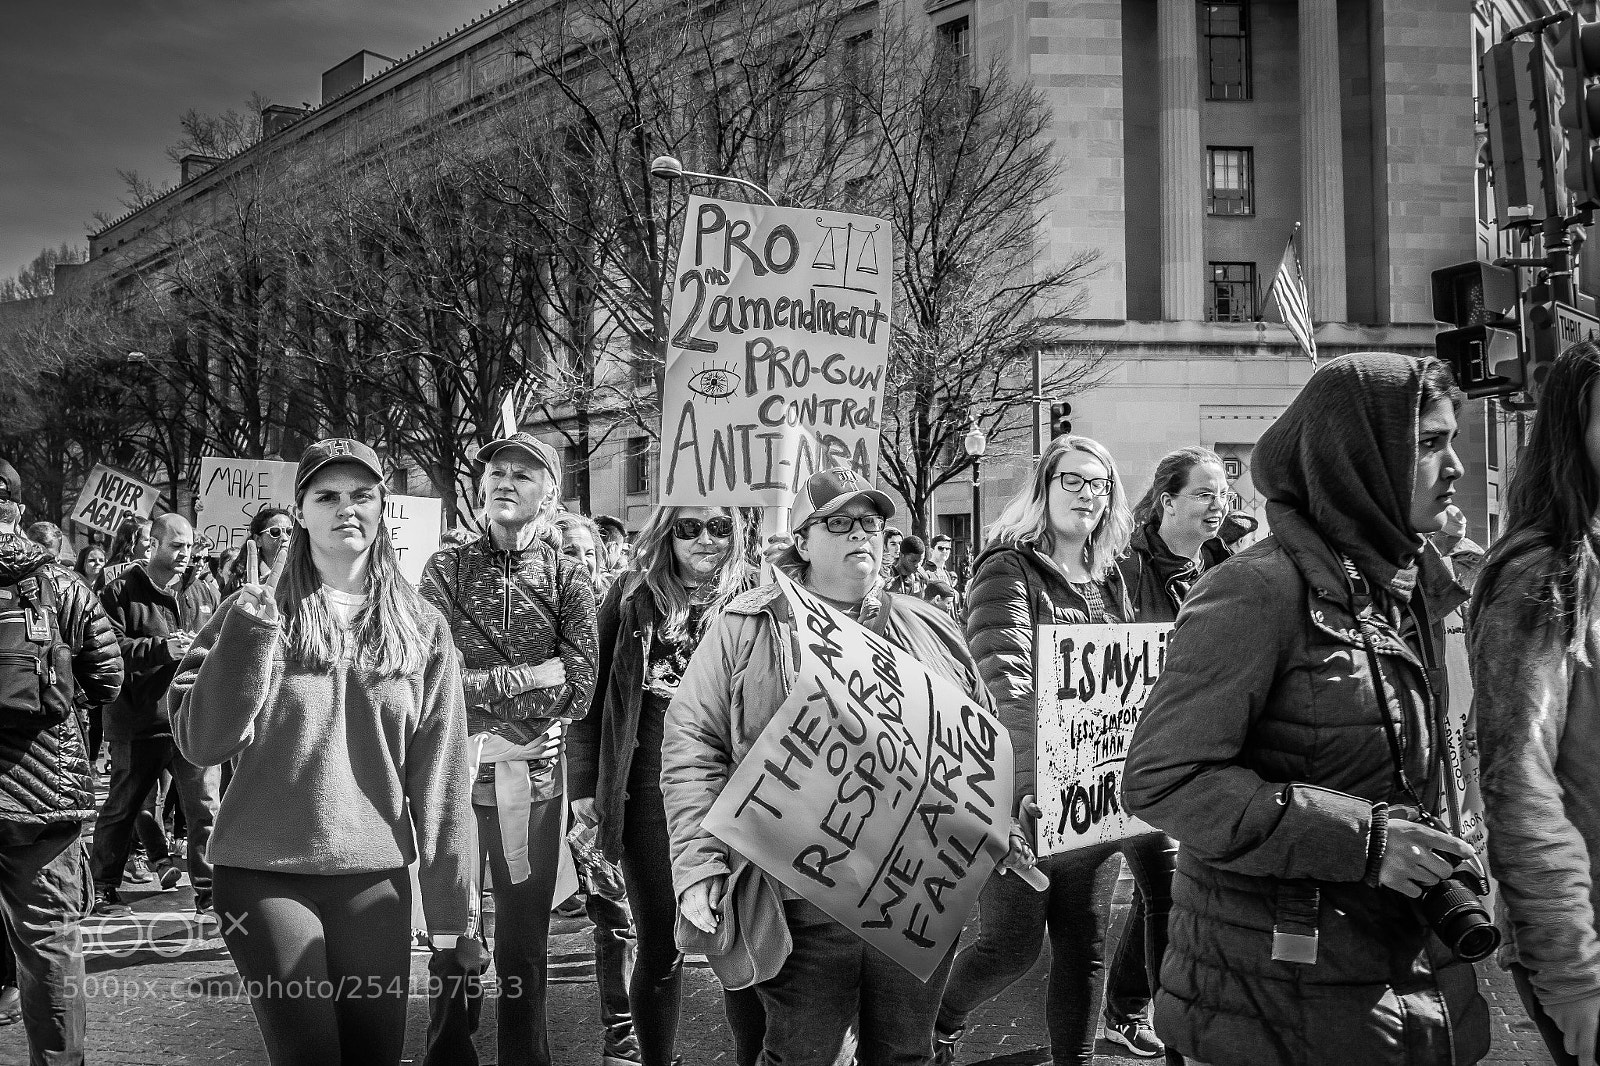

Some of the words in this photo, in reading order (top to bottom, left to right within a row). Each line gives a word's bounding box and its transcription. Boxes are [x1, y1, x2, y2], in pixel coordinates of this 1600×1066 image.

[695, 203, 800, 276] PRO
[708, 288, 889, 344] amendment
[744, 336, 884, 397] PRO-GUN
[328, 440, 352, 458] H
[665, 400, 872, 497] ANTI-NRA
[94, 471, 144, 511] NEVER
[205, 467, 271, 500] MAKE
[387, 502, 409, 519] ILL
[79, 498, 124, 532] AGAI
[734, 675, 840, 819] THEY
[790, 582, 846, 685] ARE
[1057, 638, 1096, 702] IS
[1101, 641, 1143, 707] MY
[826, 670, 879, 776] OUR
[1070, 719, 1095, 749] LESS
[1094, 735, 1125, 762] THAN
[861, 845, 924, 929] WE
[918, 711, 964, 847] ARE
[902, 705, 999, 948] FAILING
[1057, 770, 1120, 835] YOUR
[1460, 811, 1484, 838] UROR
